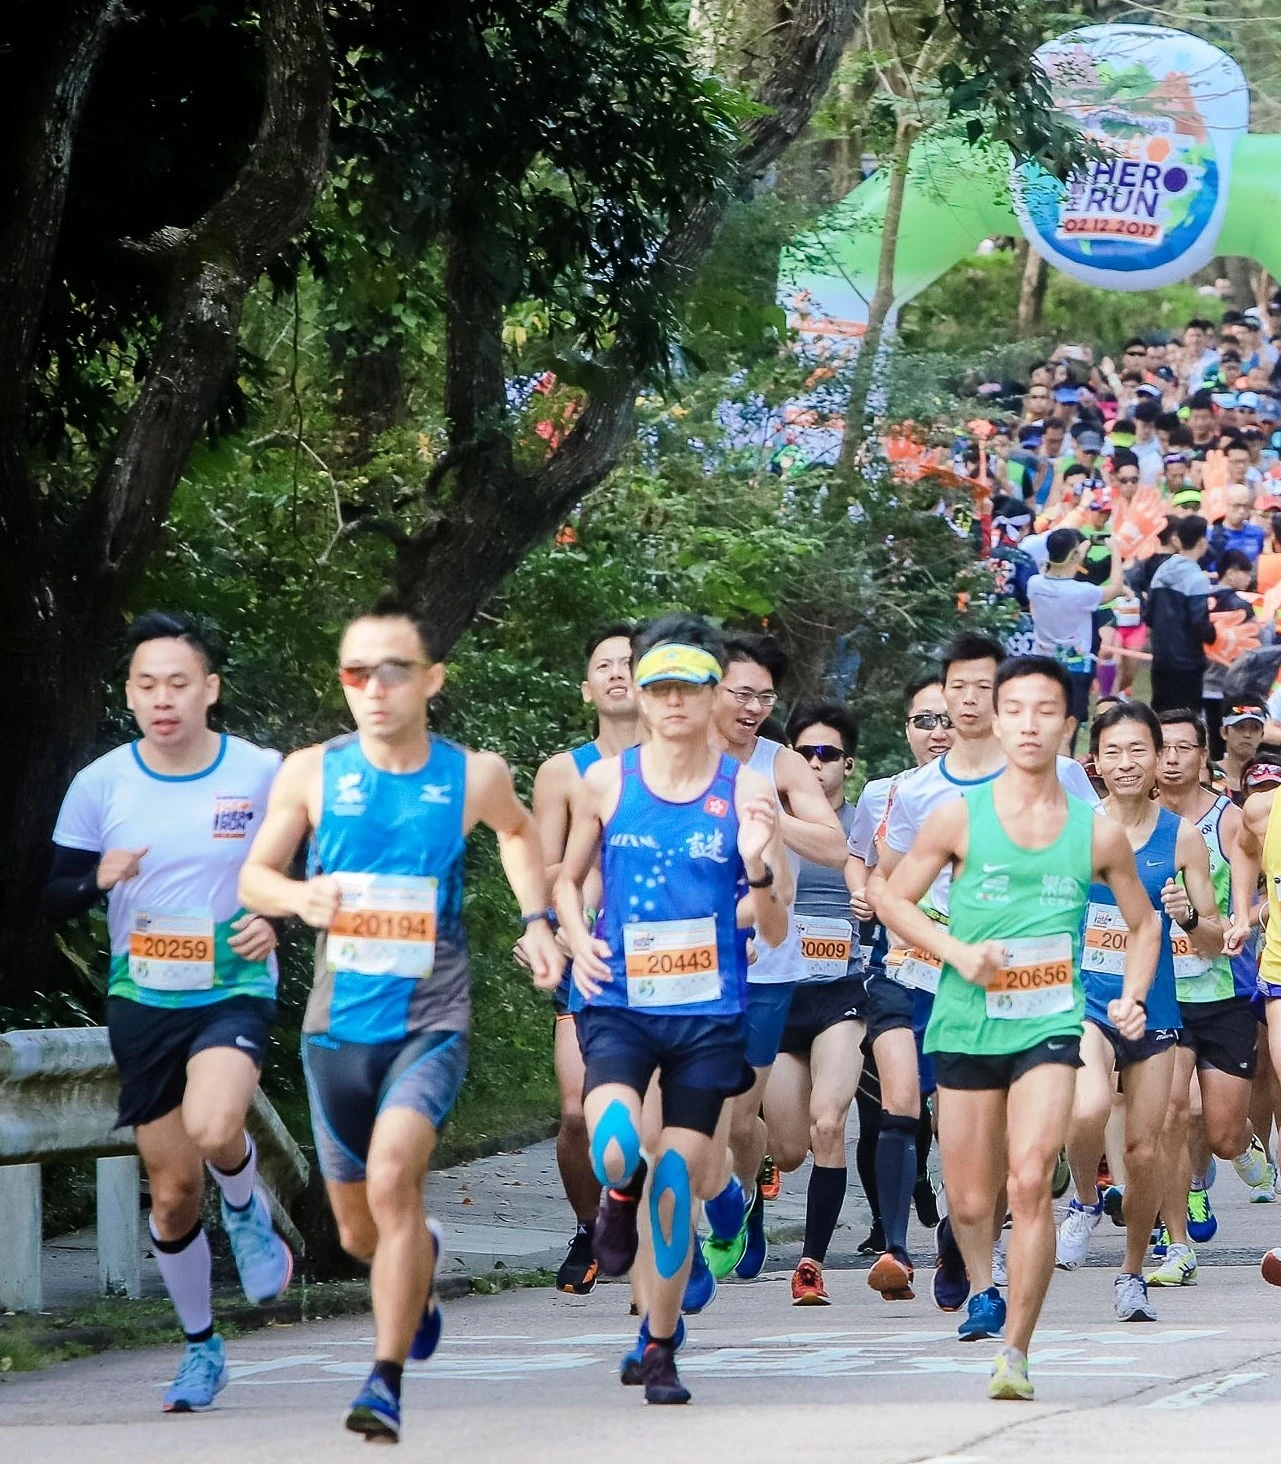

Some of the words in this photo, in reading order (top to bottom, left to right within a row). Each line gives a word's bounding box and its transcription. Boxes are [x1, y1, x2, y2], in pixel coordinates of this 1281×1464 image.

[1085, 188, 1159, 217] RUN
[352, 914, 427, 937] 20194
[144, 937, 207, 959] 20259
[647, 950, 712, 974] 20443
[1006, 964, 1067, 989] 20656
